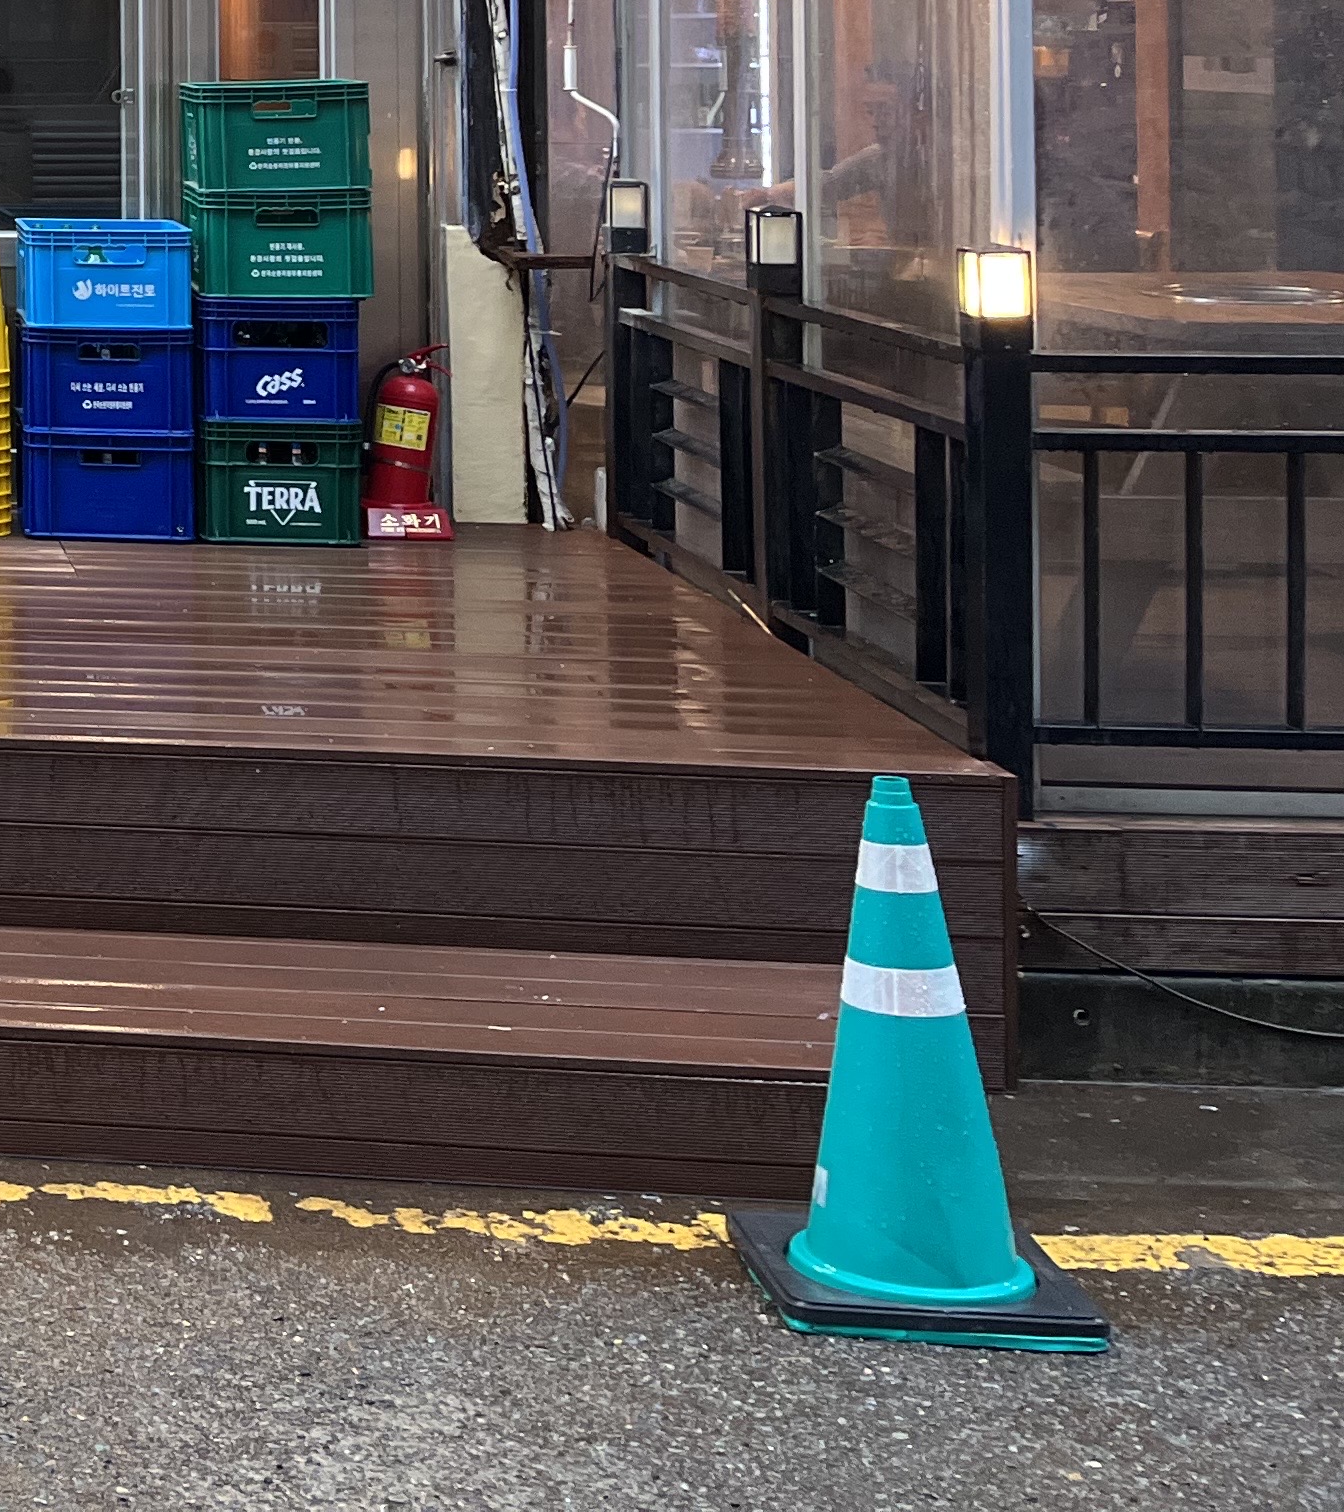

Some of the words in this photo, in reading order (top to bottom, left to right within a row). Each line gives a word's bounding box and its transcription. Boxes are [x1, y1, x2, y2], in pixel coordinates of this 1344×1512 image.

[94, 283, 156, 299] 하이트진로
[256, 368, 303, 397] Cass
[243, 485, 322, 514] TERRA
[380, 513, 441, 529] 소화기
